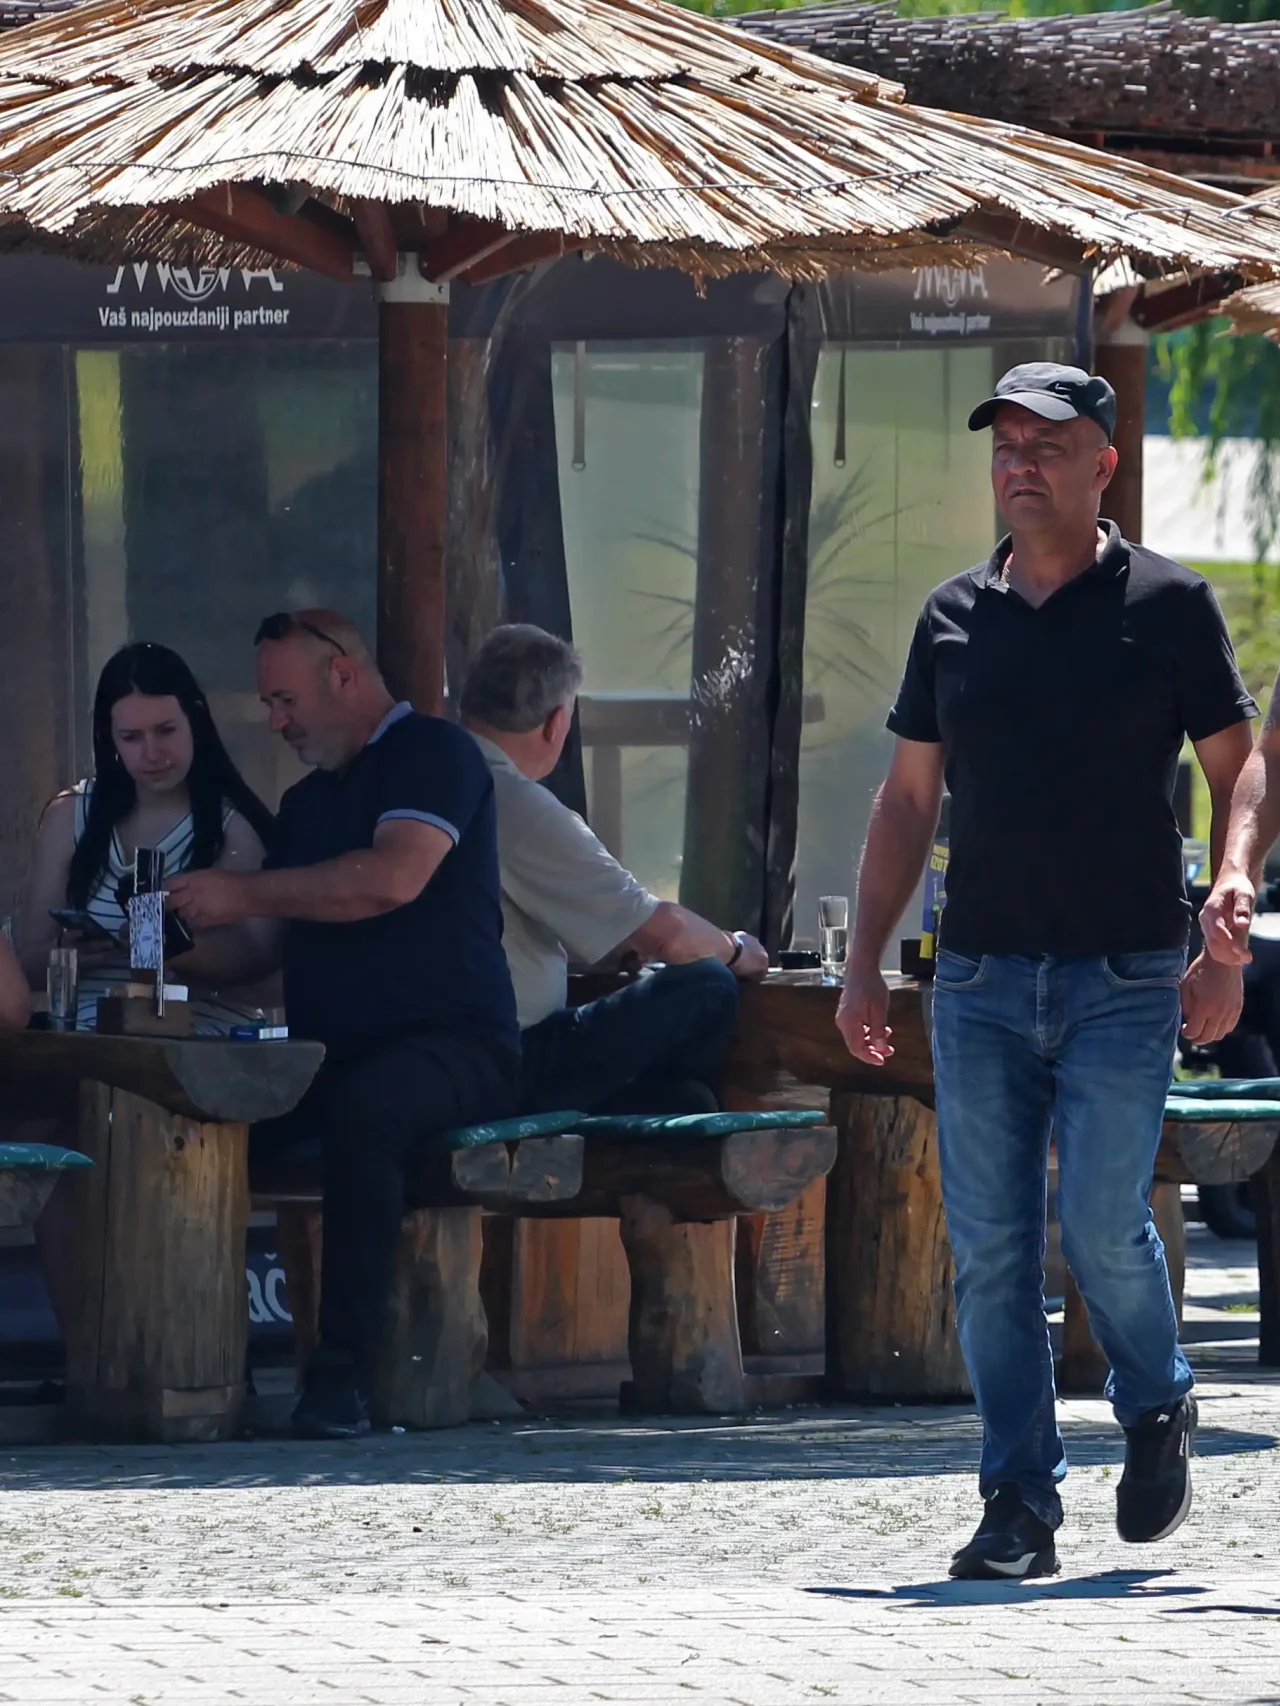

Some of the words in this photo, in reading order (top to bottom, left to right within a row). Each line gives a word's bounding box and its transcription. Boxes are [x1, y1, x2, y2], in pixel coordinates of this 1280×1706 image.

[99, 306, 127, 327] Vaš
[131, 306, 229, 331] najpouzdaniji
[234, 306, 290, 330] partner
